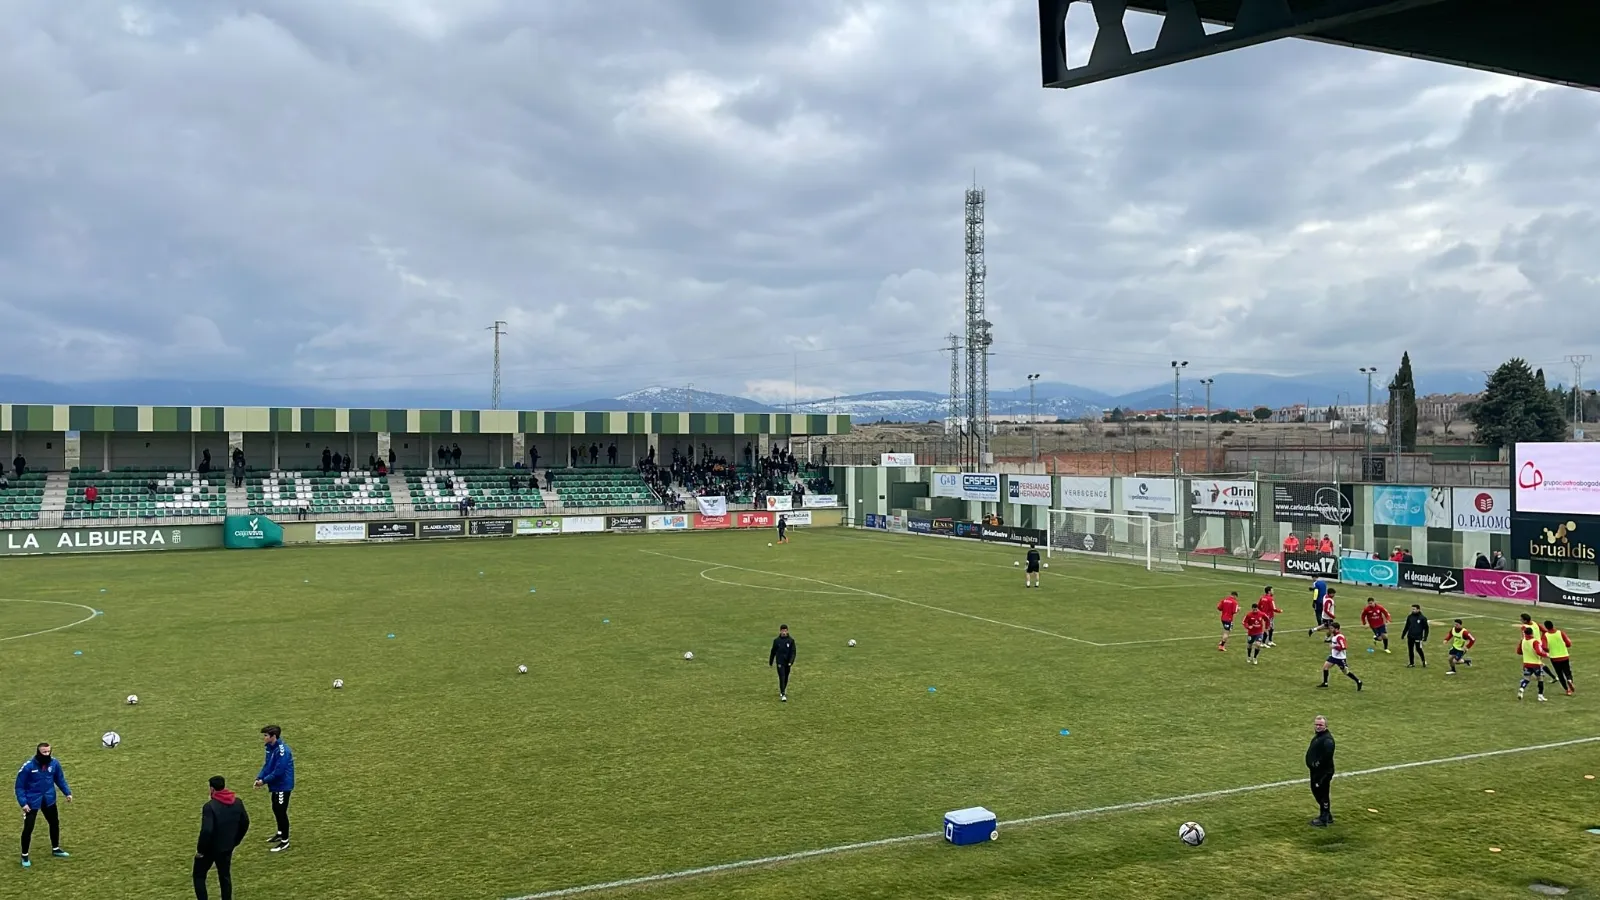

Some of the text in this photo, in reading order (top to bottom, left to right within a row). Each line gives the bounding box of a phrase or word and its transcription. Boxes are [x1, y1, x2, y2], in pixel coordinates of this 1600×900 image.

[963, 476, 996, 486] CASPER
[1019, 482, 1050, 491] PERSIANAS
[1019, 490, 1051, 499] HERNANDO
[1064, 489, 1108, 498] VERESCENCE
[1457, 513, 1511, 530] O. PALOMO
[8, 529, 165, 549] LA ALBUERA
[1529, 539, 1596, 560] brualdis
[1404, 570, 1441, 584] el decantador
